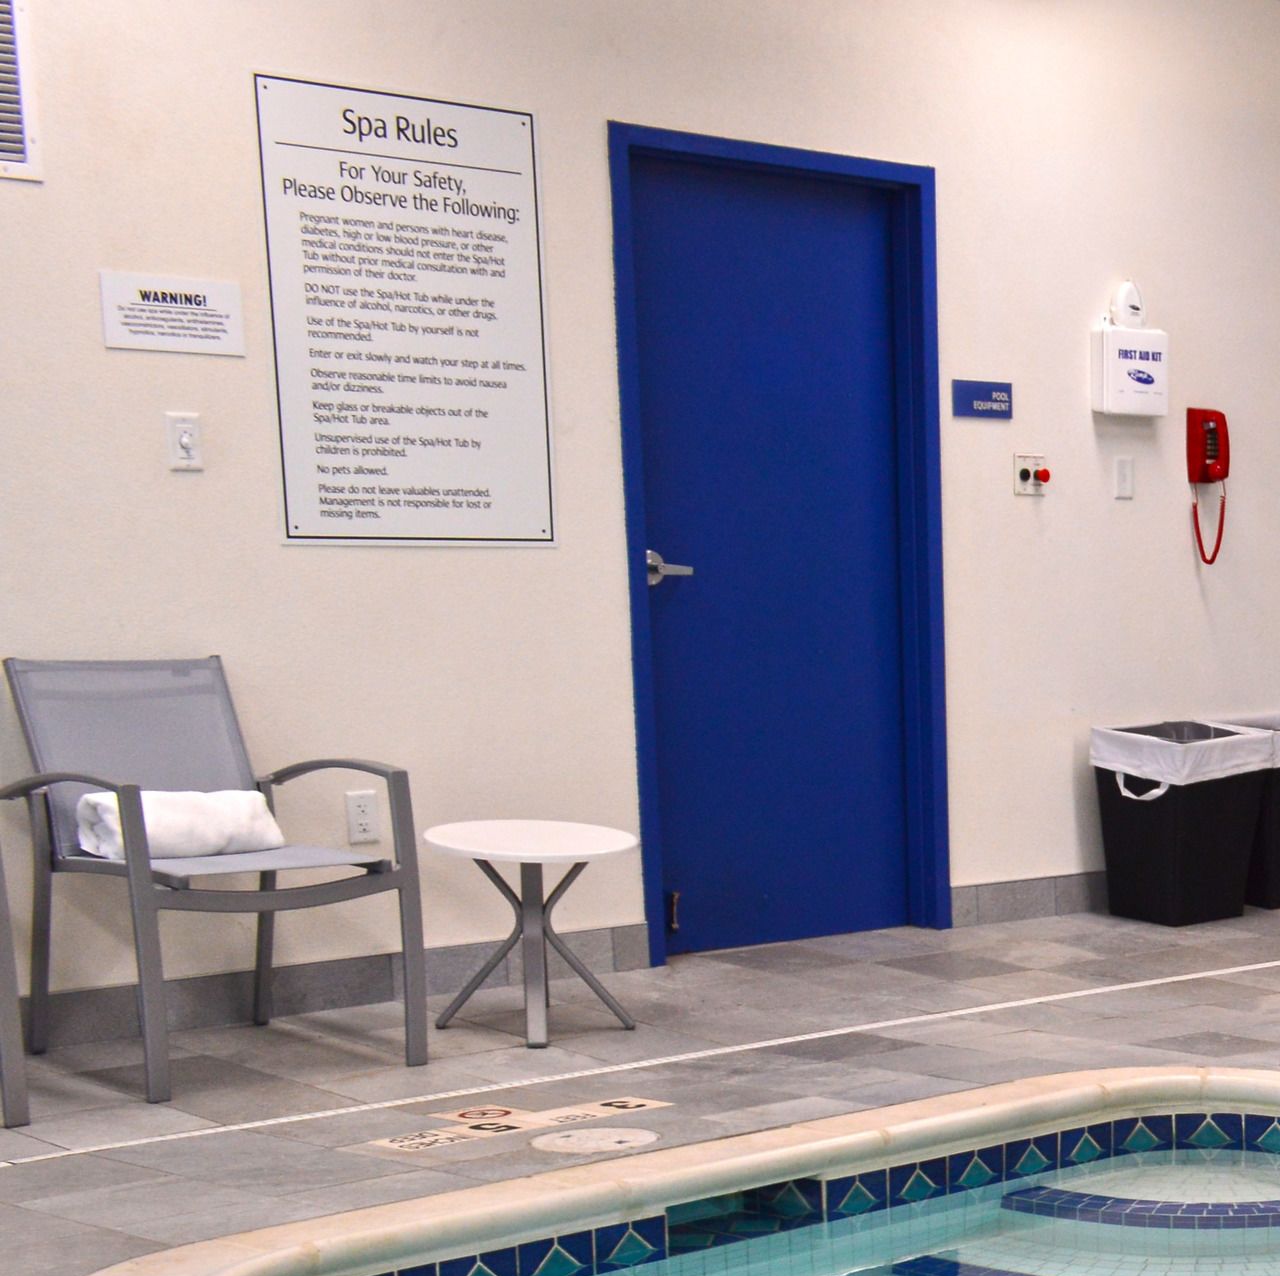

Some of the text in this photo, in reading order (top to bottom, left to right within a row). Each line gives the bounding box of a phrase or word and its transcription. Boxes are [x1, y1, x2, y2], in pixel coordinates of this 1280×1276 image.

[341, 108, 458, 148] Spa Rules
[339, 161, 466, 196] For Your Safety,
[282, 176, 520, 225] Please Observe the Following:
[299, 211, 339, 228] Pregnant
[341, 218, 374, 230] women
[376, 220, 393, 232] and
[395, 223, 429, 237] persons
[431, 225, 449, 236] with
[451, 228, 473, 238] heart
[301, 238, 335, 249] medical
[338, 241, 383, 253] conditions
[386, 246, 413, 256] should
[416, 250, 430, 258] not
[433, 252, 453, 260] enter
[457, 253, 470, 262] the
[343, 229, 361, 241] high
[376, 233, 391, 242] low
[394, 235, 418, 245] blood
[472, 243, 493, 252] other
[139, 289, 207, 306] WARNING!
[304, 282, 319, 293] DO
[321, 284, 340, 294] NOT
[342, 288, 358, 296] use
[360, 288, 374, 297] the
[413, 292, 429, 302] Tub
[430, 293, 453, 304] while
[454, 295, 479, 307] under
[481, 297, 494, 308] the
[305, 295, 345, 307] influence
[347, 298, 356, 308] of
[448, 307, 470, 317] other
[306, 316, 323, 325] Use
[325, 317, 334, 326] of
[337, 318, 351, 327] the
[390, 322, 406, 332] Tub
[408, 323, 419, 334] by
[421, 324, 454, 337] yourself
[456, 327, 463, 336] is
[465, 328, 479, 337] not
[308, 348, 331, 358] Enter
[334, 351, 343, 359] or
[346, 350, 362, 360] exit
[364, 351, 392, 364] slowly
[394, 353, 410, 363] and
[412, 355, 438, 365] watch
[439, 358, 459, 368] your
[460, 359, 478, 369] step
[480, 360, 488, 368] at
[491, 360, 500, 369] all
[1118, 349, 1162, 362] FIRST AID KIT
[310, 368, 507, 388] Observe reasonable time limits to avoid nausea
[973, 400, 1009, 411] EQUIPMENT
[992, 392, 1008, 401] POOL
[312, 400, 334, 412] Keep
[336, 401, 358, 413] glass
[371, 403, 413, 414] breakable
[415, 405, 446, 418] objects
[447, 408, 461, 416] out
[463, 407, 473, 417] of
[475, 408, 488, 418] the
[314, 432, 372, 446] Unsupervised
[374, 437, 389, 446] use
[391, 435, 400, 444] of
[402, 435, 416, 447] the
[454, 438, 469, 447] Tub
[470, 438, 481, 449] by
[316, 464, 330, 473] No
[331, 466, 351, 476] pets
[318, 483, 345, 493] Please
[347, 485, 359, 493] do
[361, 486, 375, 494] not
[378, 485, 400, 494] leave
[401, 485, 440, 495] valuables
[319, 496, 375, 508] Management
[377, 497, 384, 506] is
[386, 498, 401, 506] not
[403, 498, 449, 509] responsible
[451, 499, 463, 508] for
[466, 499, 481, 508] lost
[600, 1101, 646, 1109] 3
[469, 1122, 521, 1133] 5
